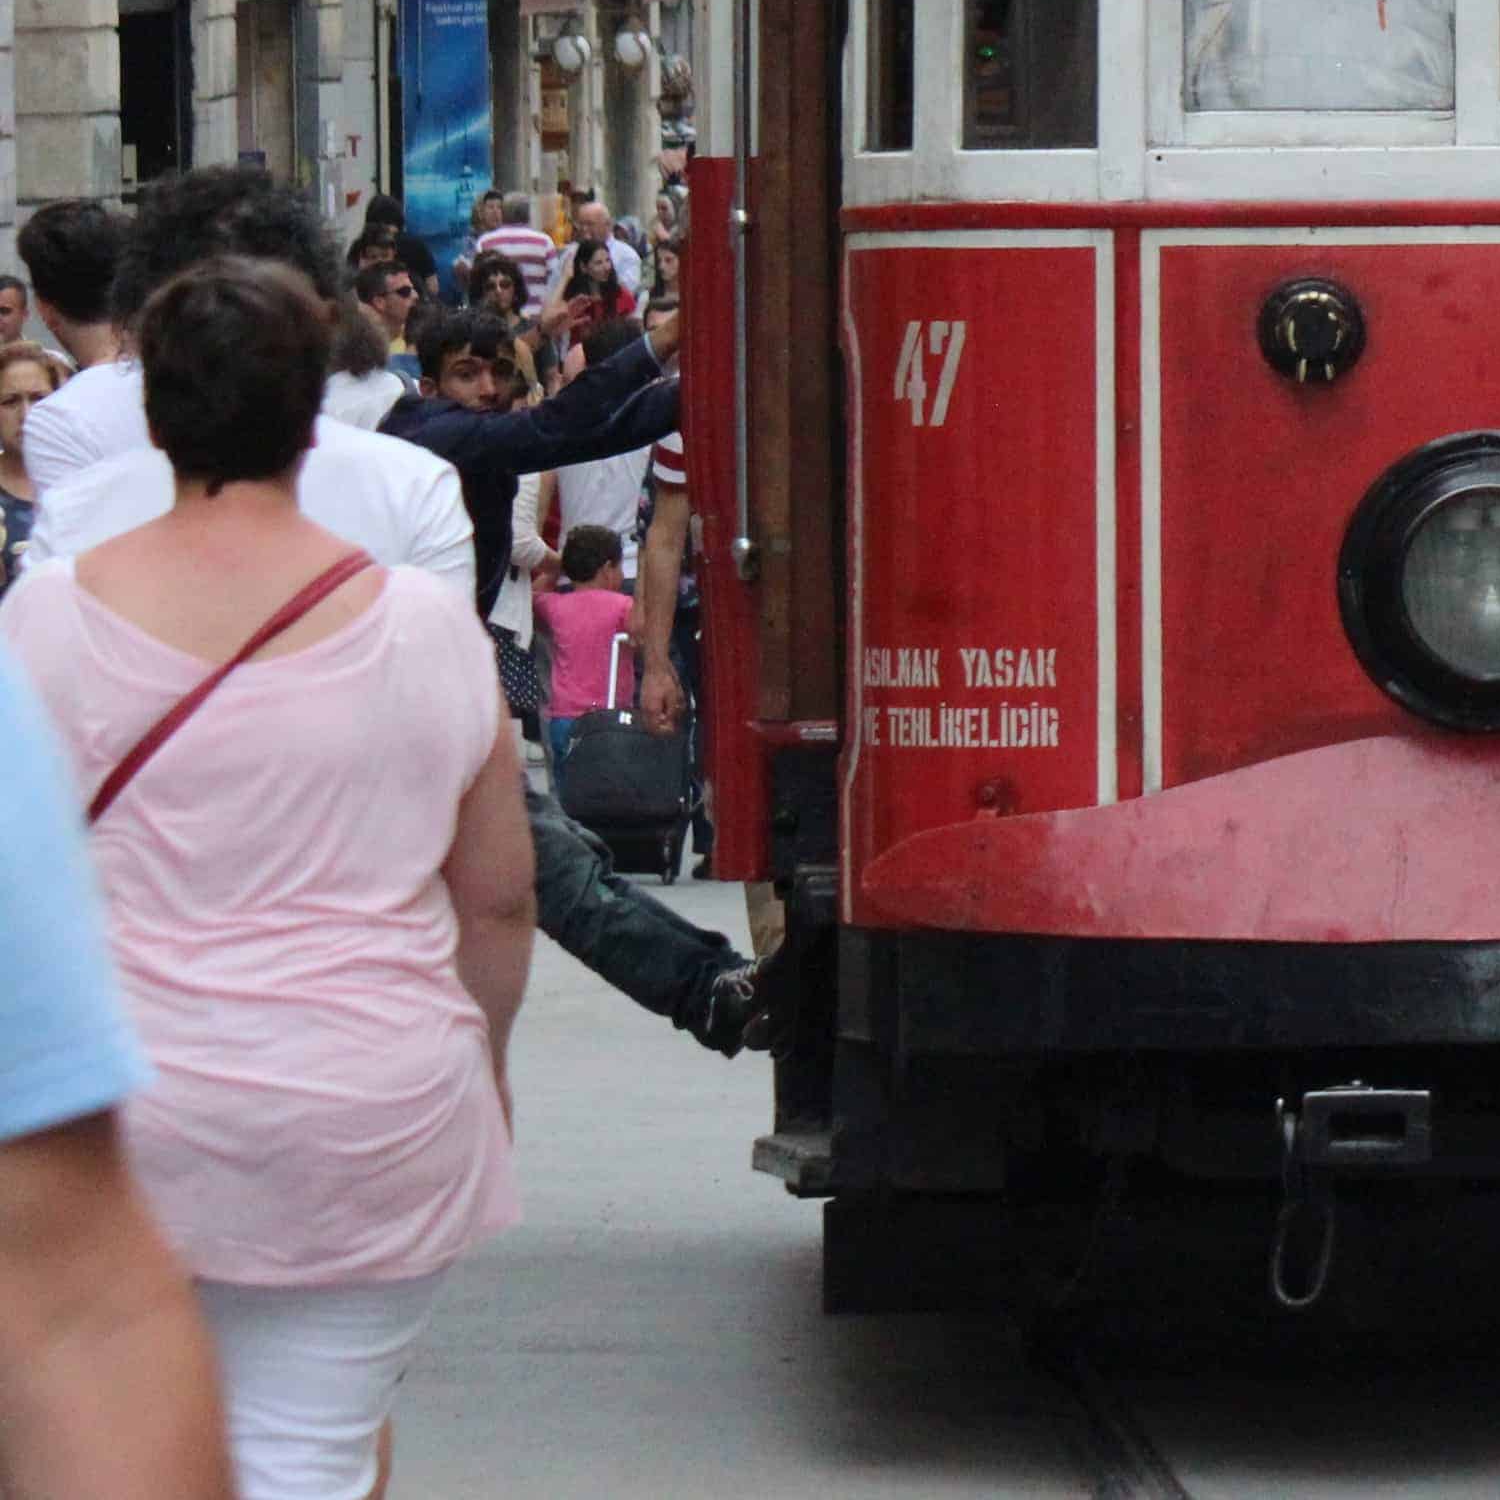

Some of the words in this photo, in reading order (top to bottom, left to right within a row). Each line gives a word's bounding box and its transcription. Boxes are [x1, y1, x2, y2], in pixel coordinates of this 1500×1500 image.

[896, 320, 966, 427] 47
[864, 648, 940, 687] ASILMAK
[960, 648, 1058, 687] YASAK
[888, 701, 1060, 749] TEHLİKELİDİR
